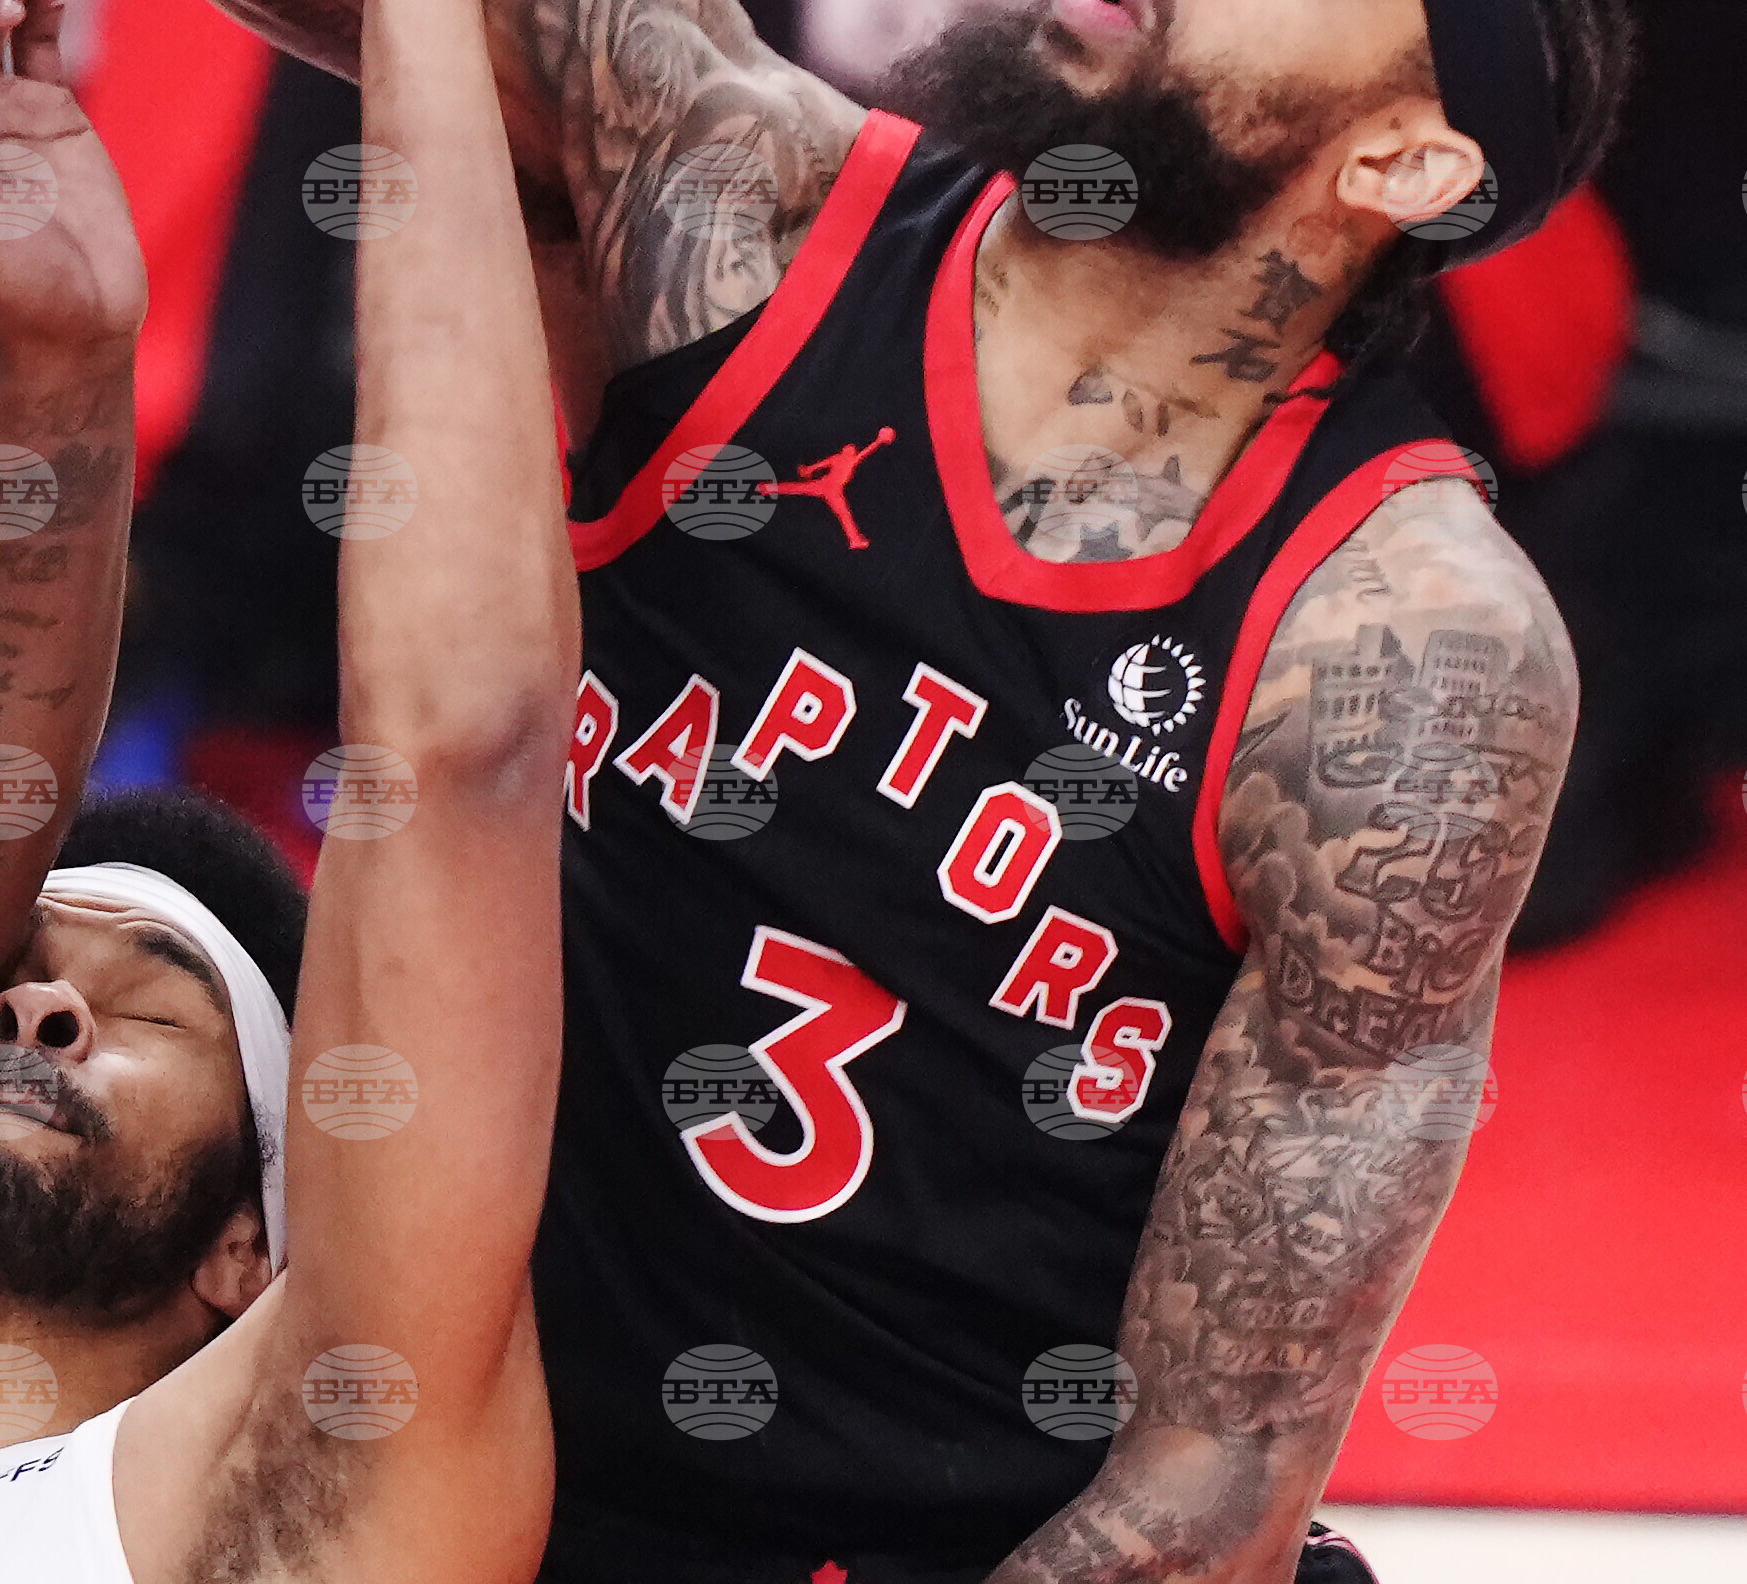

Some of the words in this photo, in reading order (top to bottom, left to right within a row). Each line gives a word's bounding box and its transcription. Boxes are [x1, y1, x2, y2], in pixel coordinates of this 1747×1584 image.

[564, 646, 1171, 1123] RAPTORS
[1064, 698, 1120, 758] Sun
[1120, 735, 1188, 793] Life
[681, 924, 908, 1224] 3
